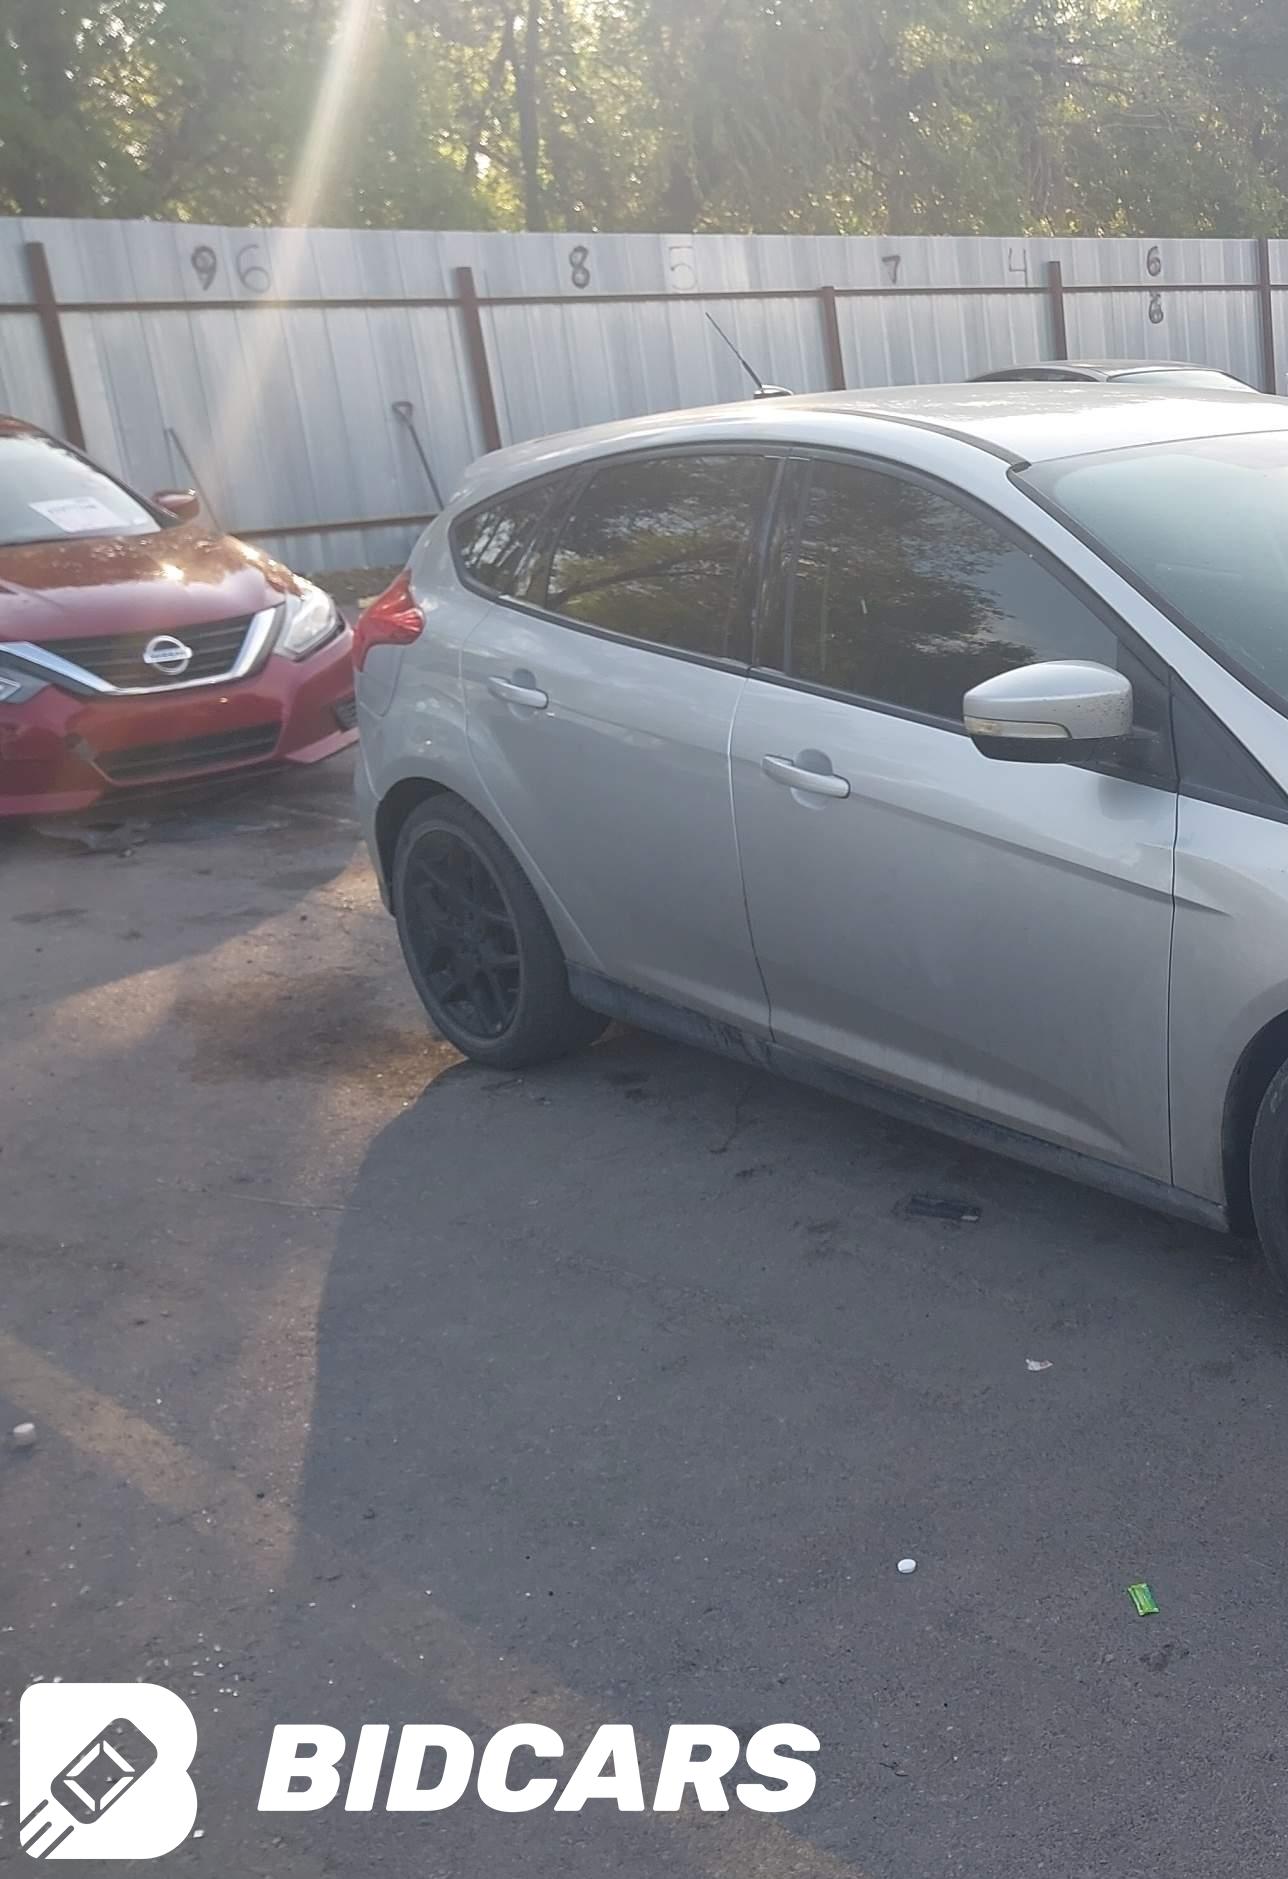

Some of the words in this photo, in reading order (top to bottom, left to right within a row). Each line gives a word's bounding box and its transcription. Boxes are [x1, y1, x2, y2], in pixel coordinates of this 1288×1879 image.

[569, 245, 591, 289] 8
[881, 254, 901, 285] 7
[1008, 247, 1029, 288] 4
[1147, 246, 1162, 276] 6
